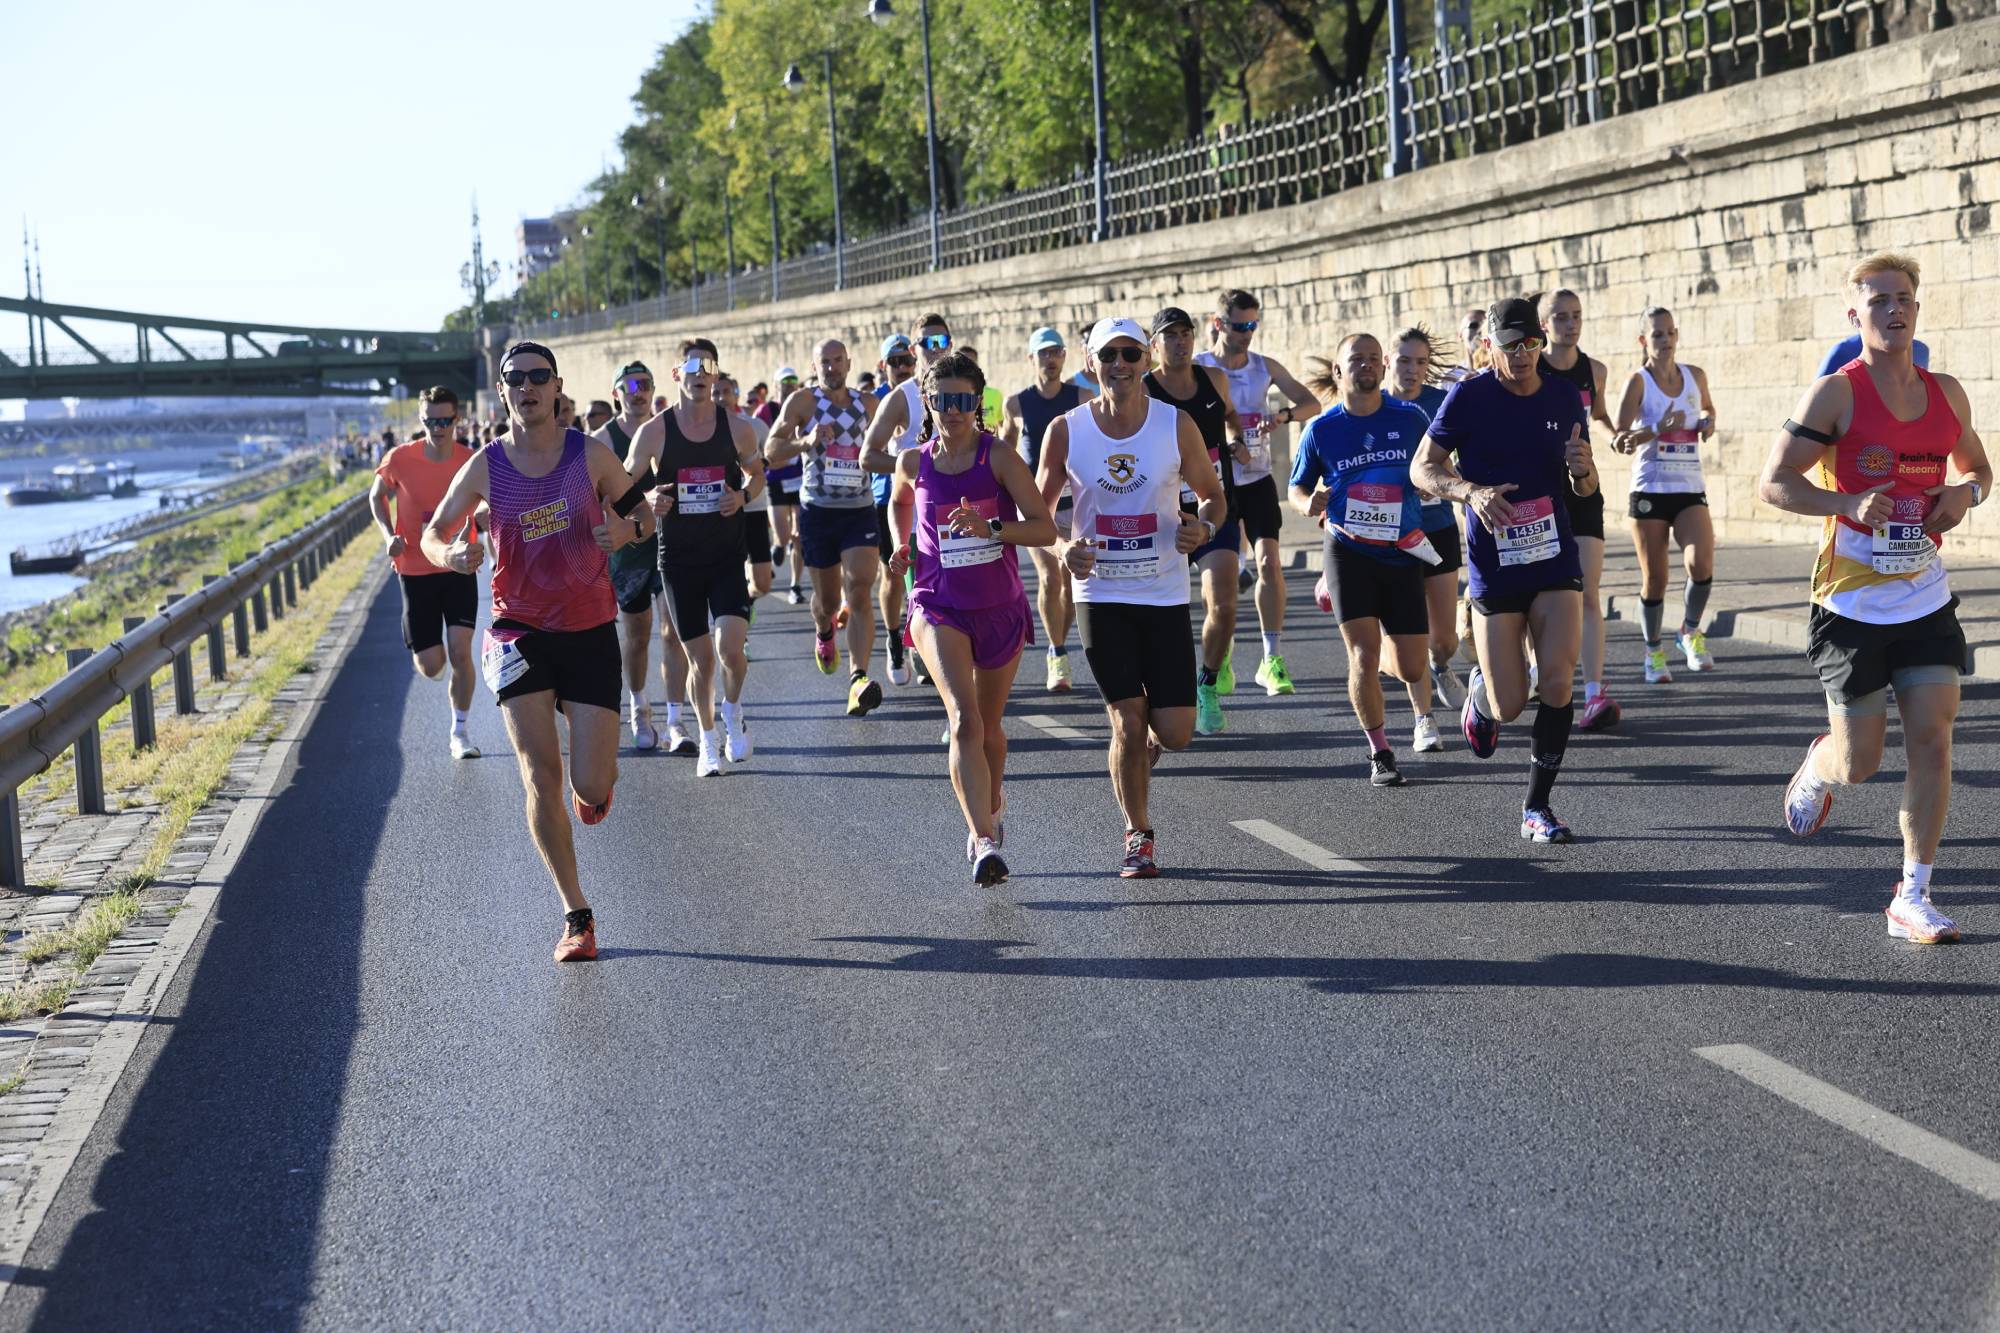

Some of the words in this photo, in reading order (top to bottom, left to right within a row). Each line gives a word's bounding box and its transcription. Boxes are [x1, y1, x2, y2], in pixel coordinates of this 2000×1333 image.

[1336, 448, 1407, 471] EMERSON
[1899, 453, 1923, 462] Brain
[695, 485, 714, 493] 460
[526, 501, 566, 522] БОЛЬШЕ
[1349, 510, 1388, 523] 23246
[534, 515, 554, 528] ЧЕМ
[525, 521, 568, 540] МОЖЕШЬ
[1513, 522, 1545, 538] 14351
[1122, 540, 1139, 550] 50
[1511, 538, 1528, 547] ALLEN
[1888, 541, 1921, 551] CAMERON
